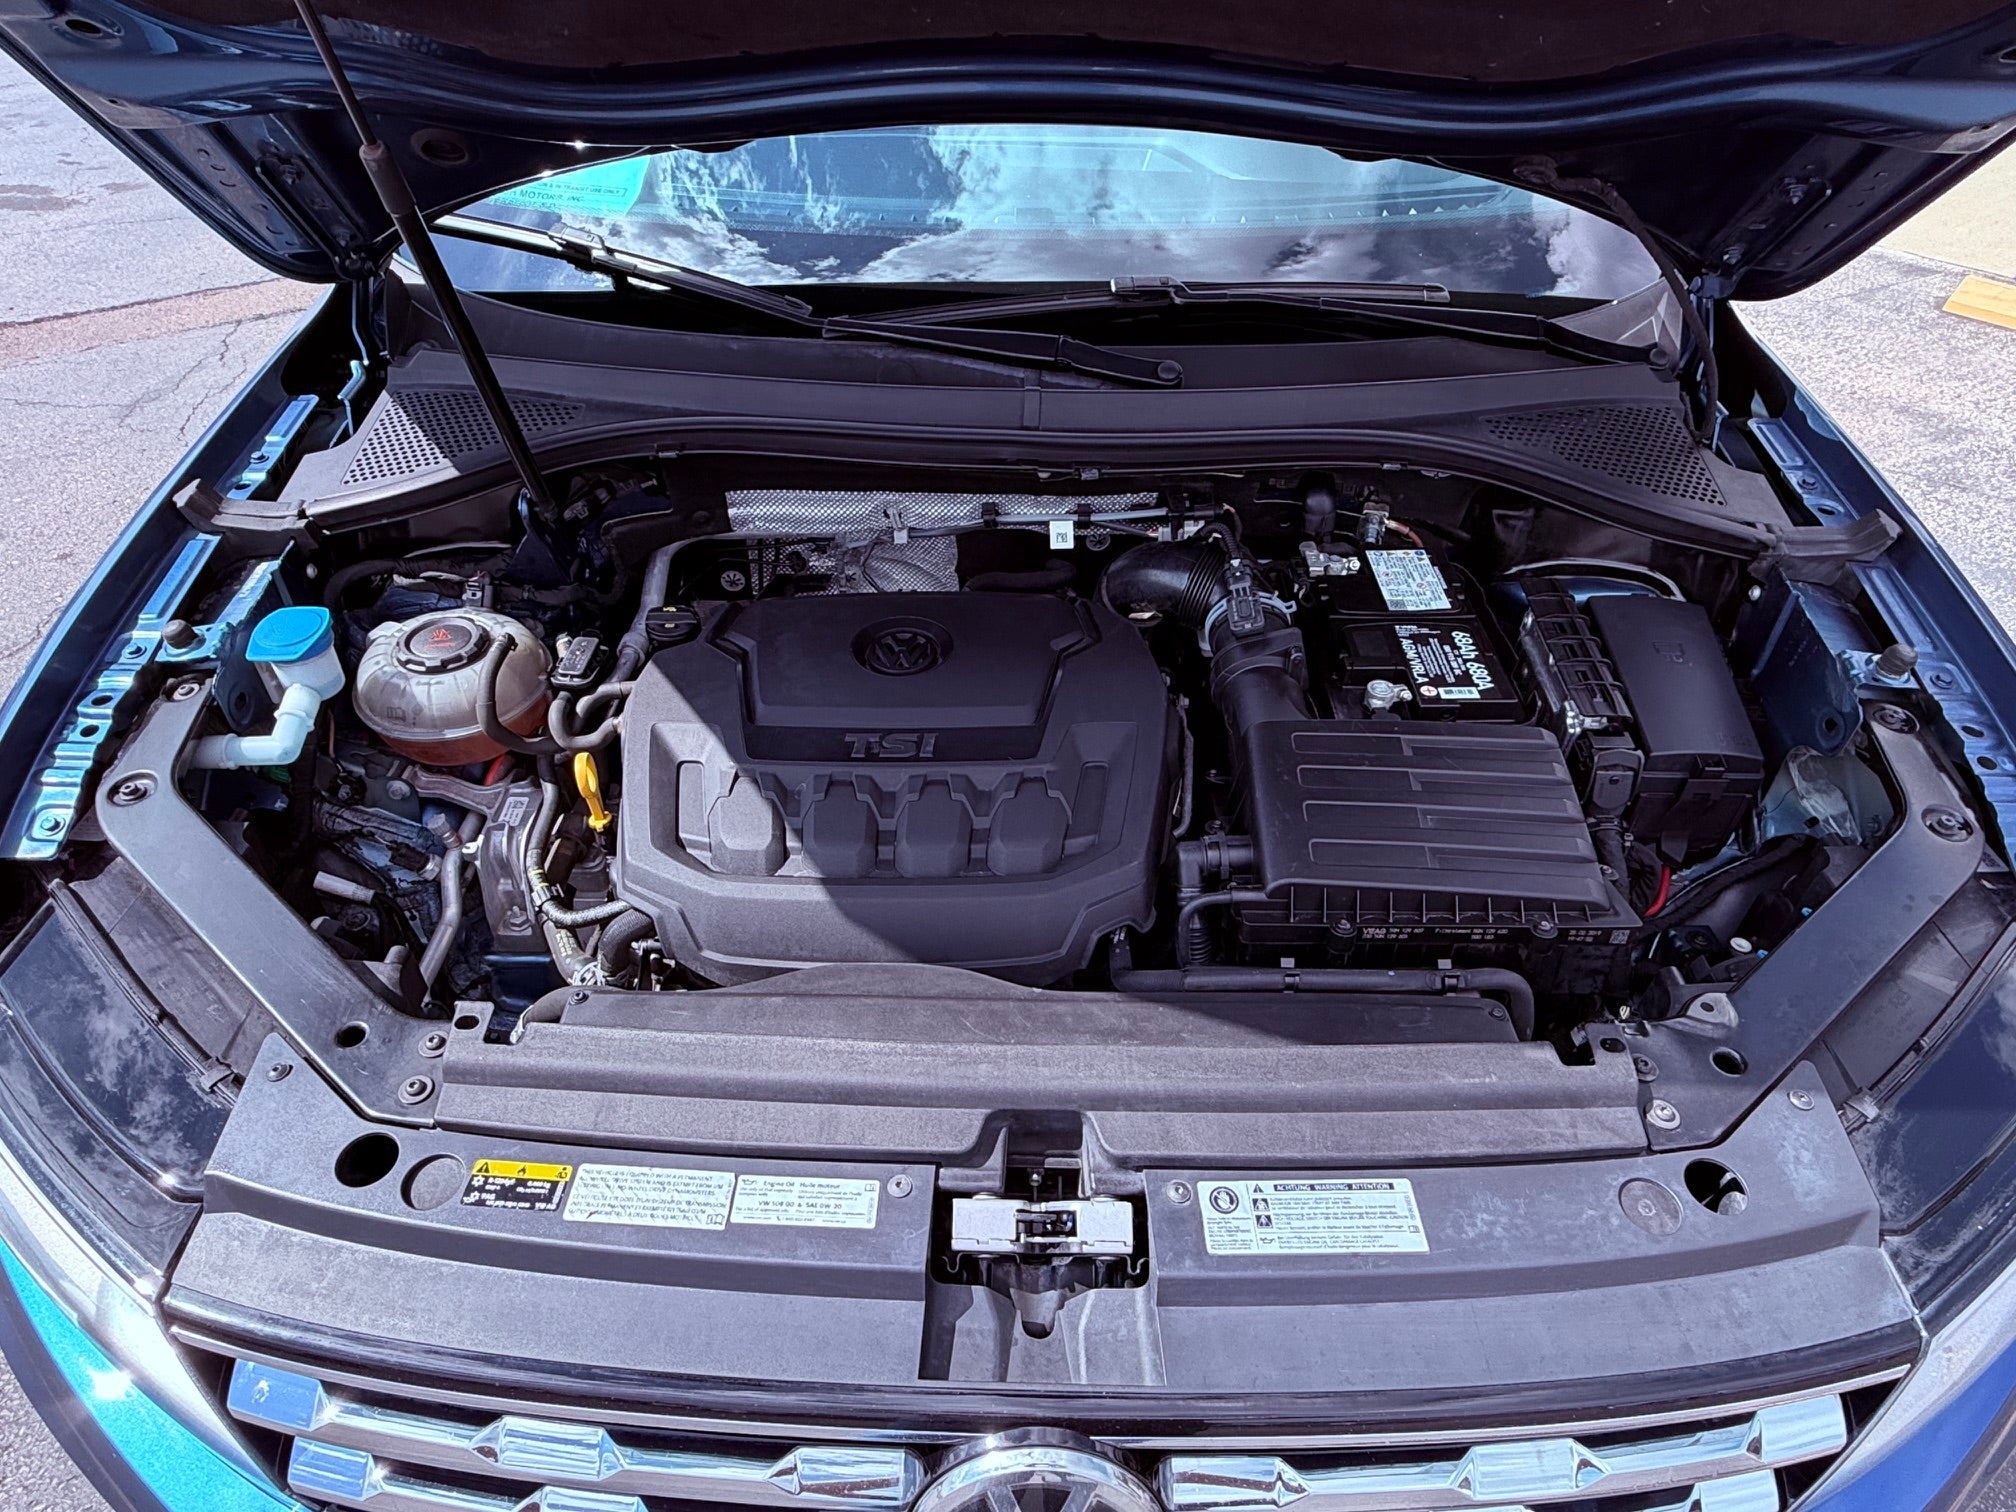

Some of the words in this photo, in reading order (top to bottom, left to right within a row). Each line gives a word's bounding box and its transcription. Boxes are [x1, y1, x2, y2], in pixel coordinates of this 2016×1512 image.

[1451, 631, 1479, 659] 68Ah
[1466, 661, 1495, 690] 680A
[844, 732, 939, 758] TSI
